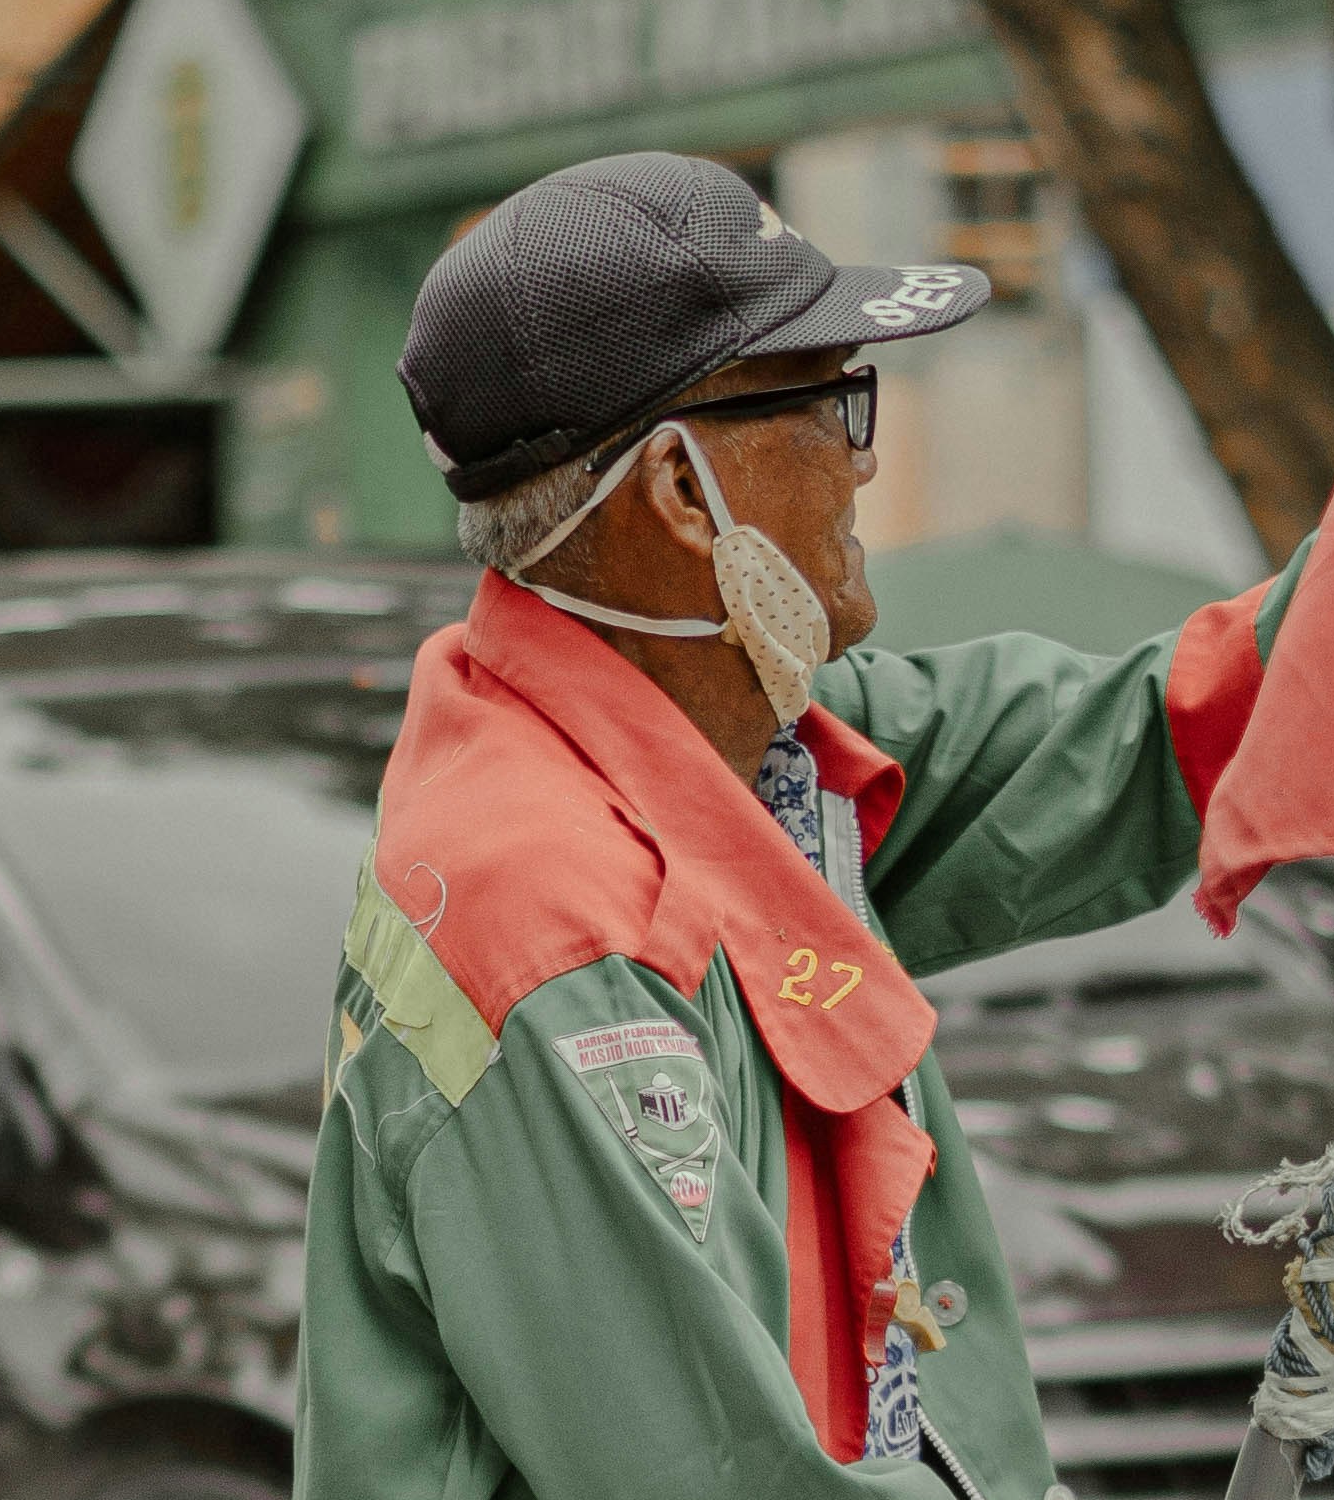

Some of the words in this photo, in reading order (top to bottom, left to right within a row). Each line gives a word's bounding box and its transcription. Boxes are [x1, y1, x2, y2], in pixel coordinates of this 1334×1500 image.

[778, 948, 863, 1010] 27
[575, 1031, 622, 1050] BARISAN
[579, 1044, 624, 1068] MASJID
[625, 1039, 657, 1057] NOOR
